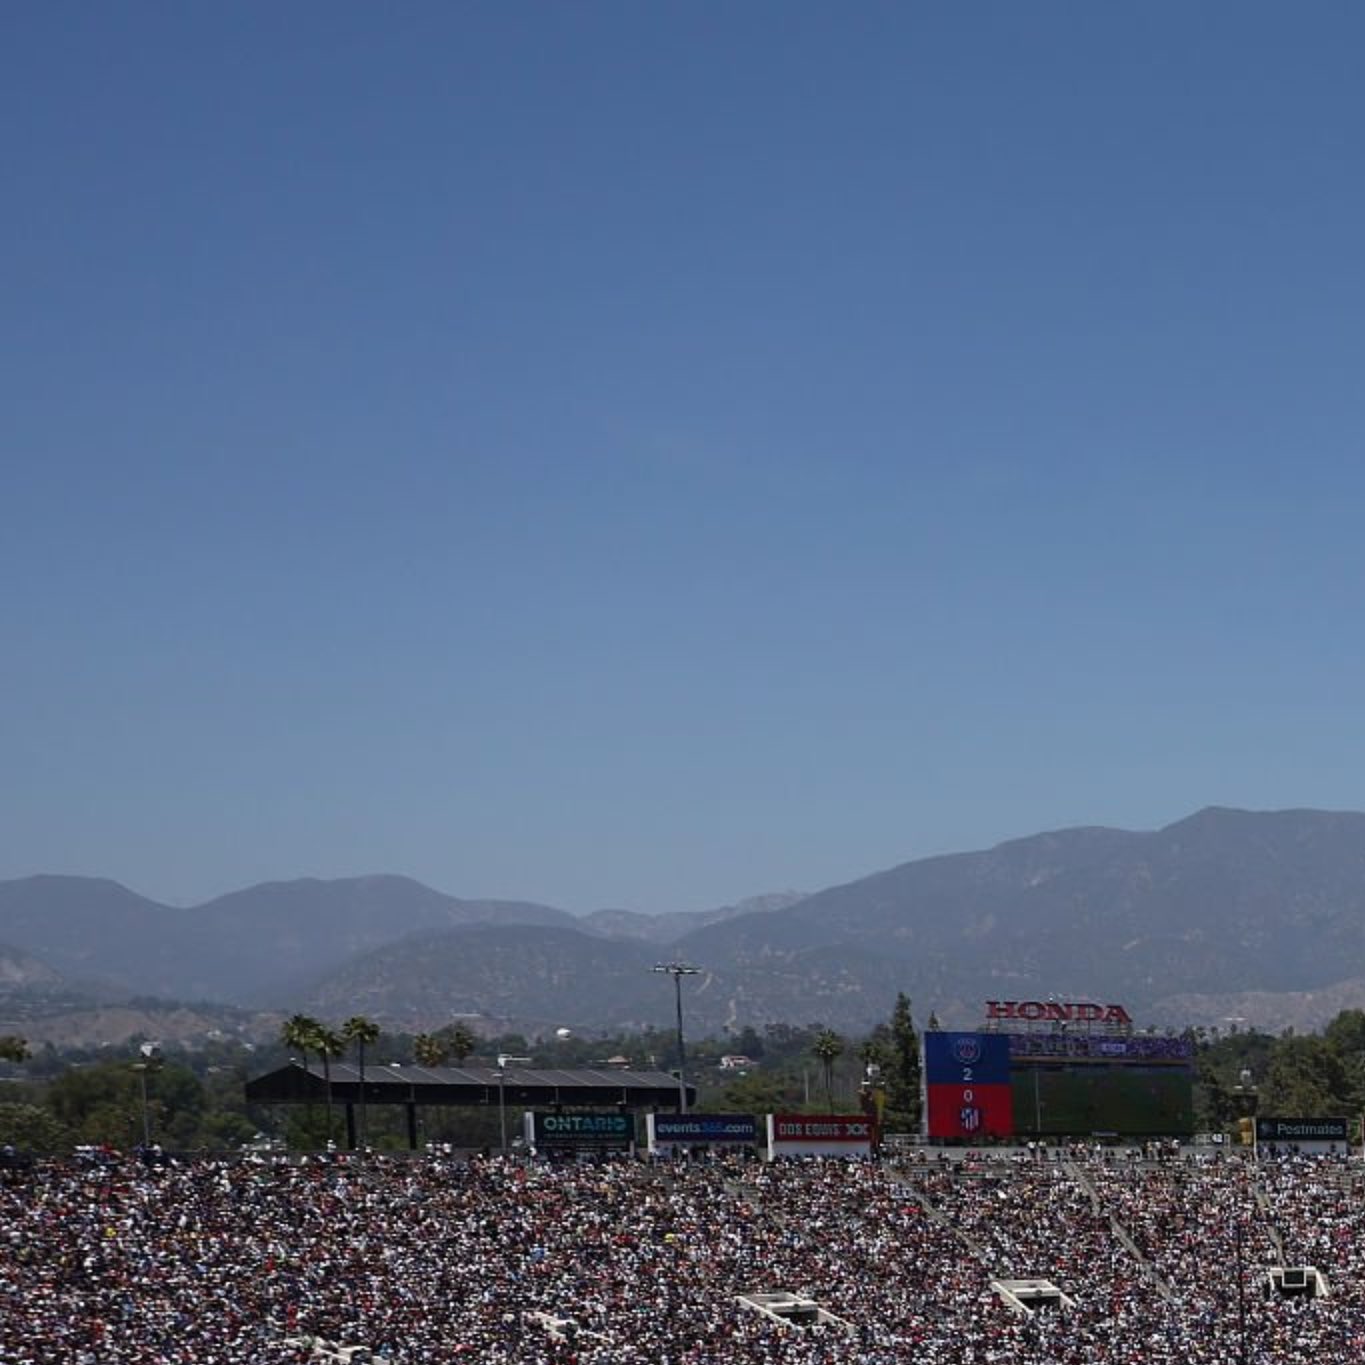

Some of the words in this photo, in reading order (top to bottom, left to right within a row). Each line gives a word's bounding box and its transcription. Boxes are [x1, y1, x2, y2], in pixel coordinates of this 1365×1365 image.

[985, 1001, 1132, 1023] HONDA
[963, 1068, 973, 1081] 2
[963, 1089, 973, 1102] 0
[543, 1117, 626, 1131] ONTARIO
[779, 1123, 801, 1135] DOS
[1277, 1123, 1343, 1135] Postmates
